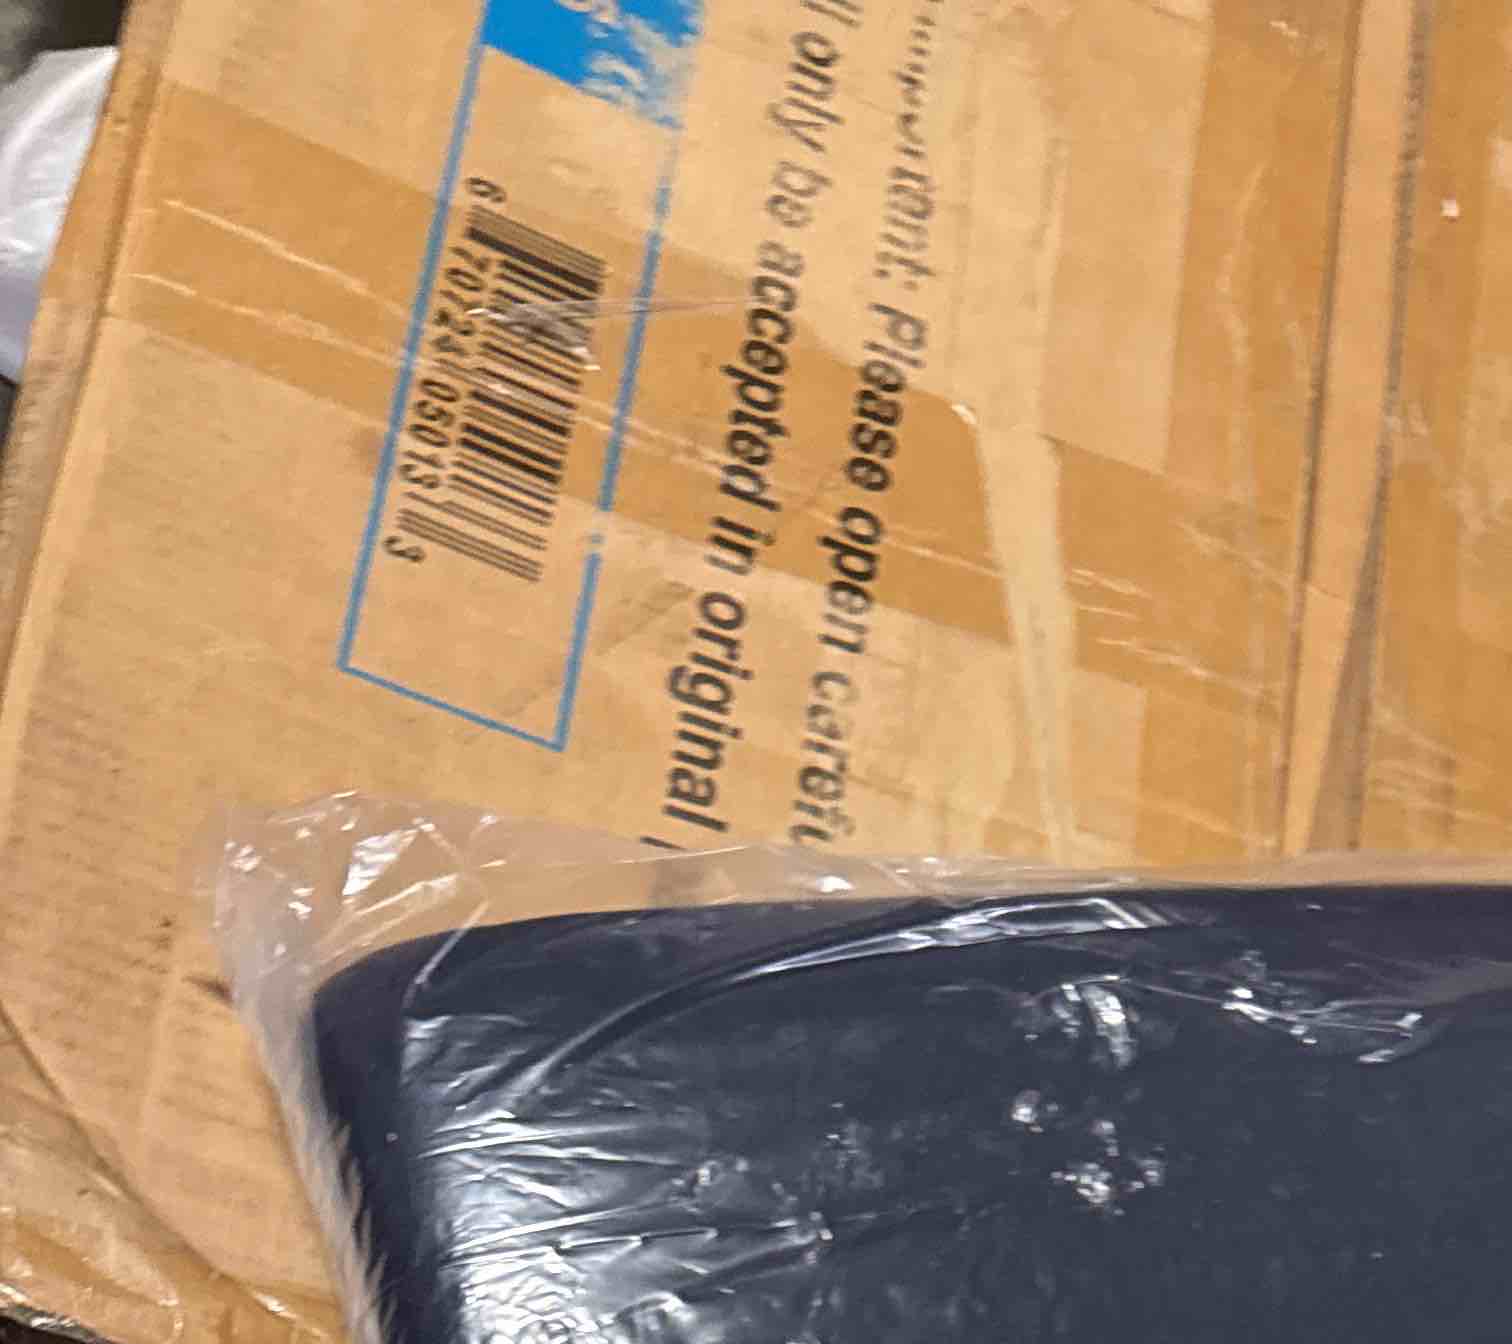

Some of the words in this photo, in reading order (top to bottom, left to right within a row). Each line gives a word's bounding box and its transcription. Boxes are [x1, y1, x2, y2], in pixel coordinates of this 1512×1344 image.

[768, 30, 845, 155] only
[781, 159, 838, 230] be
[397, 377, 463, 492] 05013
[718, 249, 804, 514] accepted
[842, 300, 928, 494] Please
[383, 535, 427, 564] 3
[708, 516, 773, 578] in
[818, 507, 886, 655] open
[662, 590, 755, 834] original
[791, 670, 862, 848] carefu
